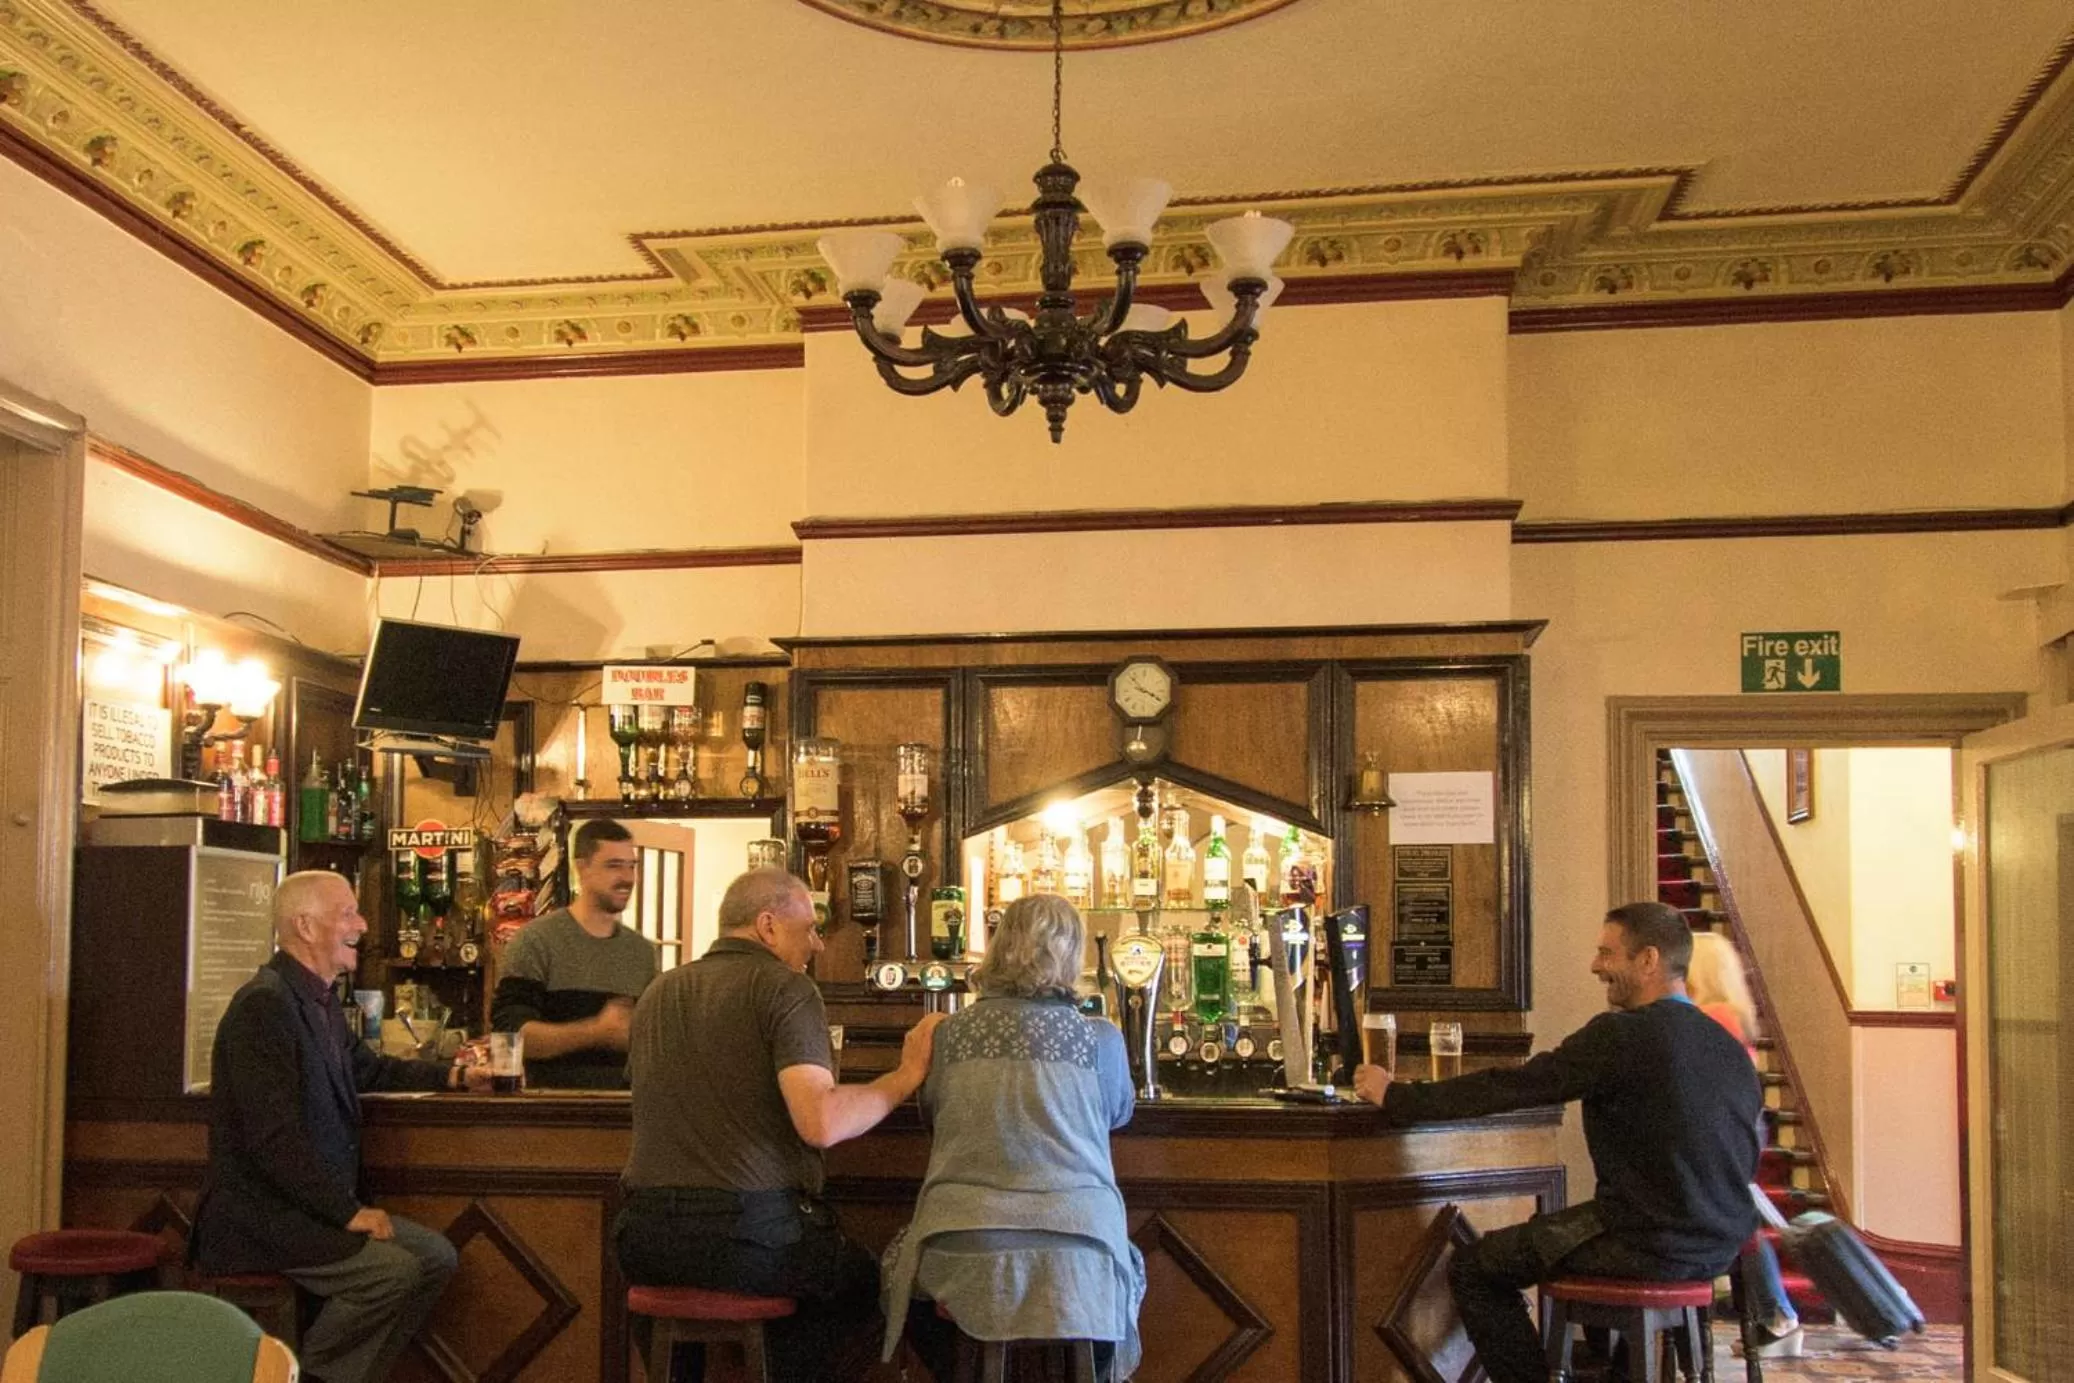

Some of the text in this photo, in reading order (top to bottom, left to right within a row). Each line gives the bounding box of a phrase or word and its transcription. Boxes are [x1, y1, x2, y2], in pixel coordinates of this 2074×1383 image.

[1743, 635, 1839, 656] Fire exit
[611, 671, 688, 683] DOUBLES
[631, 687, 664, 700] BAR
[88, 702, 98, 717] IT
[99, 705, 109, 720] IS
[110, 707, 145, 727] ILLEGAL
[92, 722, 156, 749] SELL TOBACCO
[93, 741, 155, 767] PRODUCTS TO
[88, 761, 126, 780] ANYONE
[392, 831, 469, 846] MARTINI
